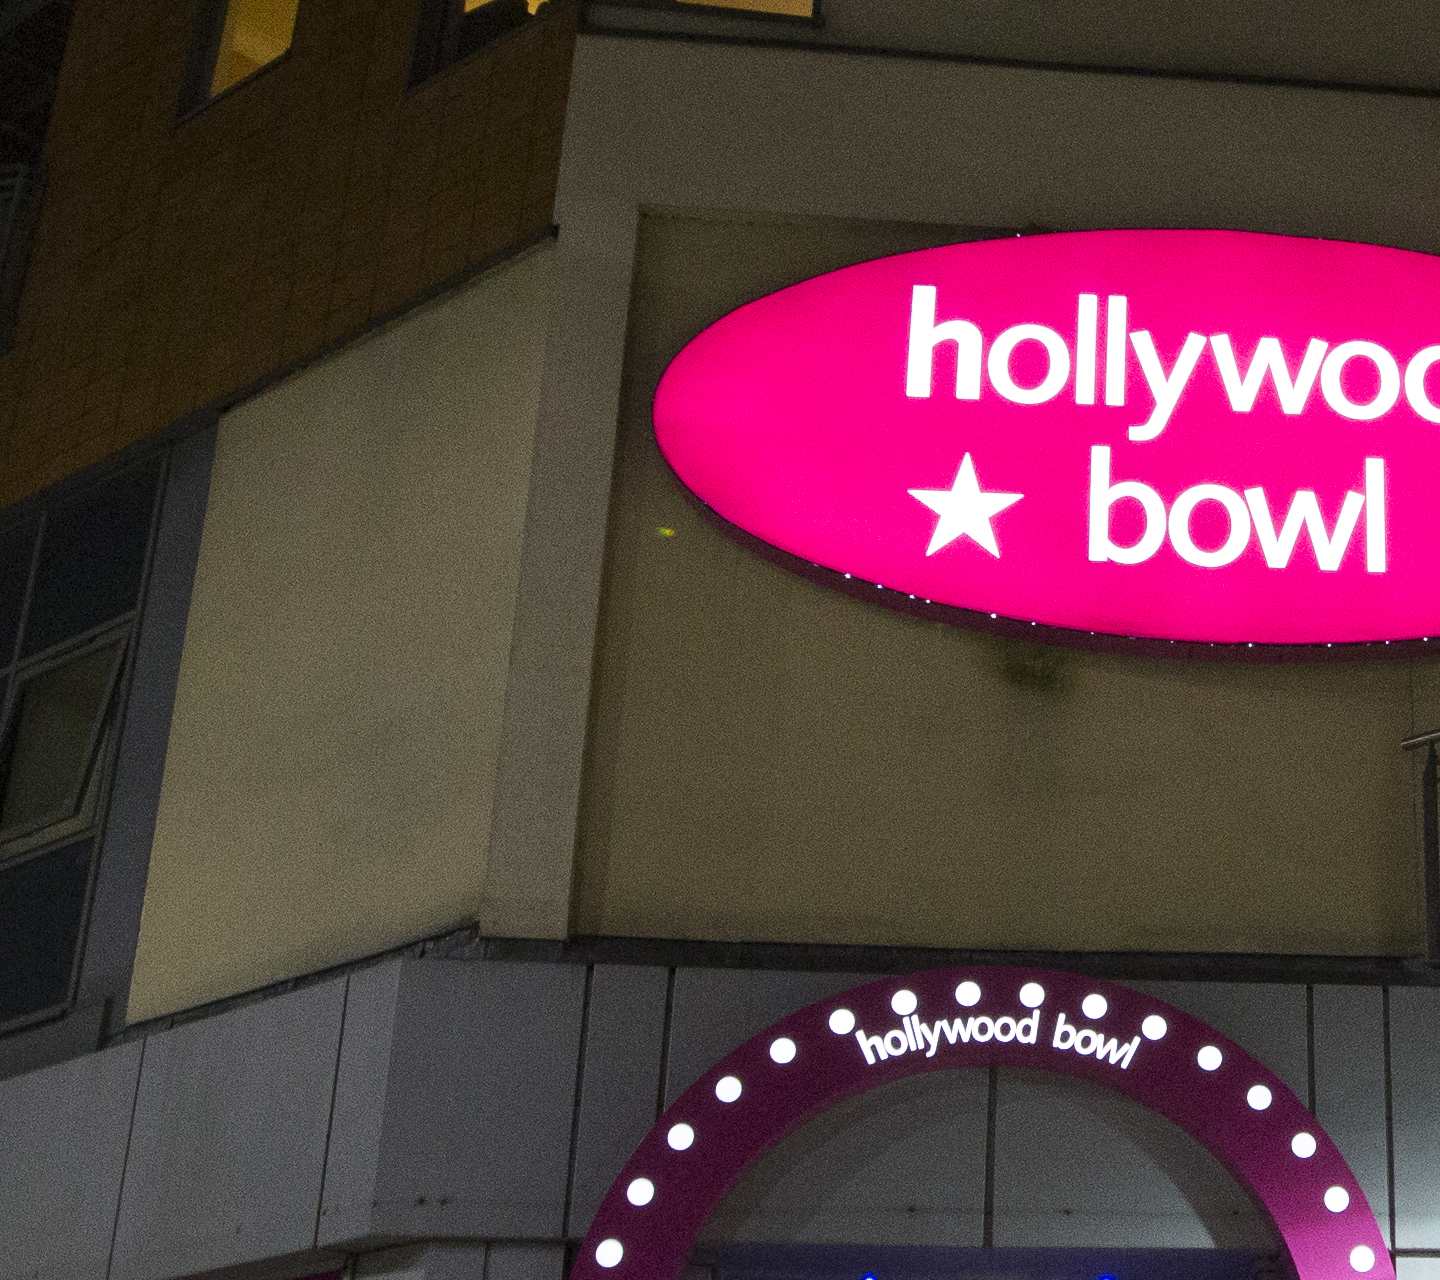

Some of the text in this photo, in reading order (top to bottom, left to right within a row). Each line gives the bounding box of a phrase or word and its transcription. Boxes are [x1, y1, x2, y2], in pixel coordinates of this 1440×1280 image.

[1088, 445, 1387, 573] bowl
[855, 1009, 1141, 1070] hollywood bowl
